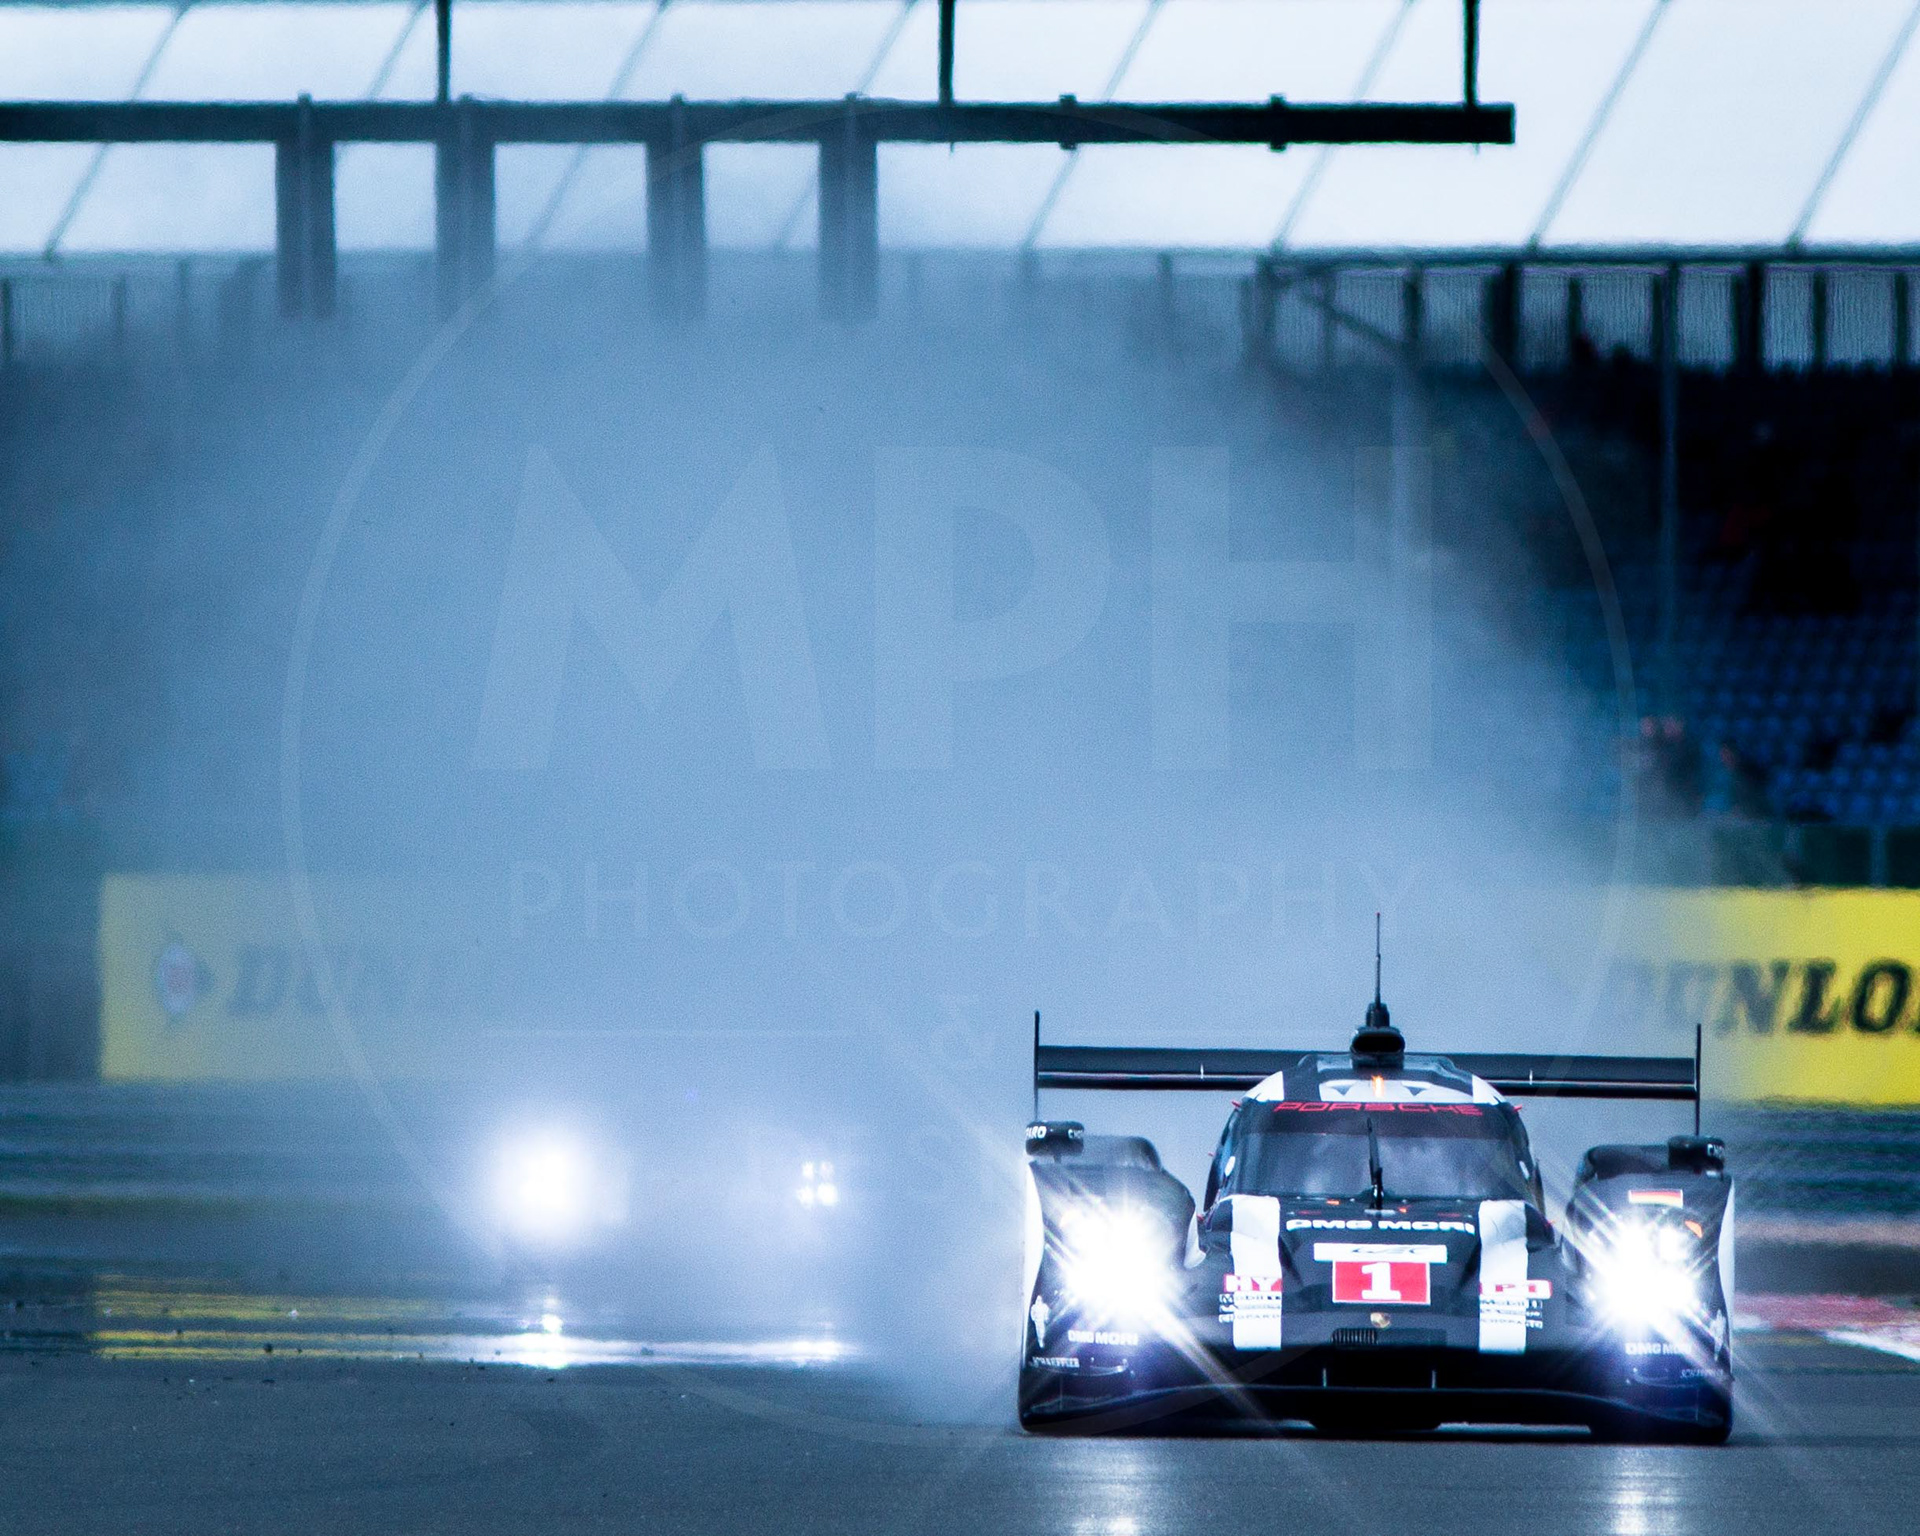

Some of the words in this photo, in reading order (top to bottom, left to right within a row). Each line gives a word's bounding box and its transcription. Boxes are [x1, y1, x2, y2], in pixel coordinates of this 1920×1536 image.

[1605, 956, 1920, 1035] DUNLO
[1274, 1101, 1483, 1116] PORSCHE
[1286, 1219, 1373, 1231] DMG
[1378, 1220, 1475, 1236] MORI
[1361, 1263, 1401, 1301] 1
